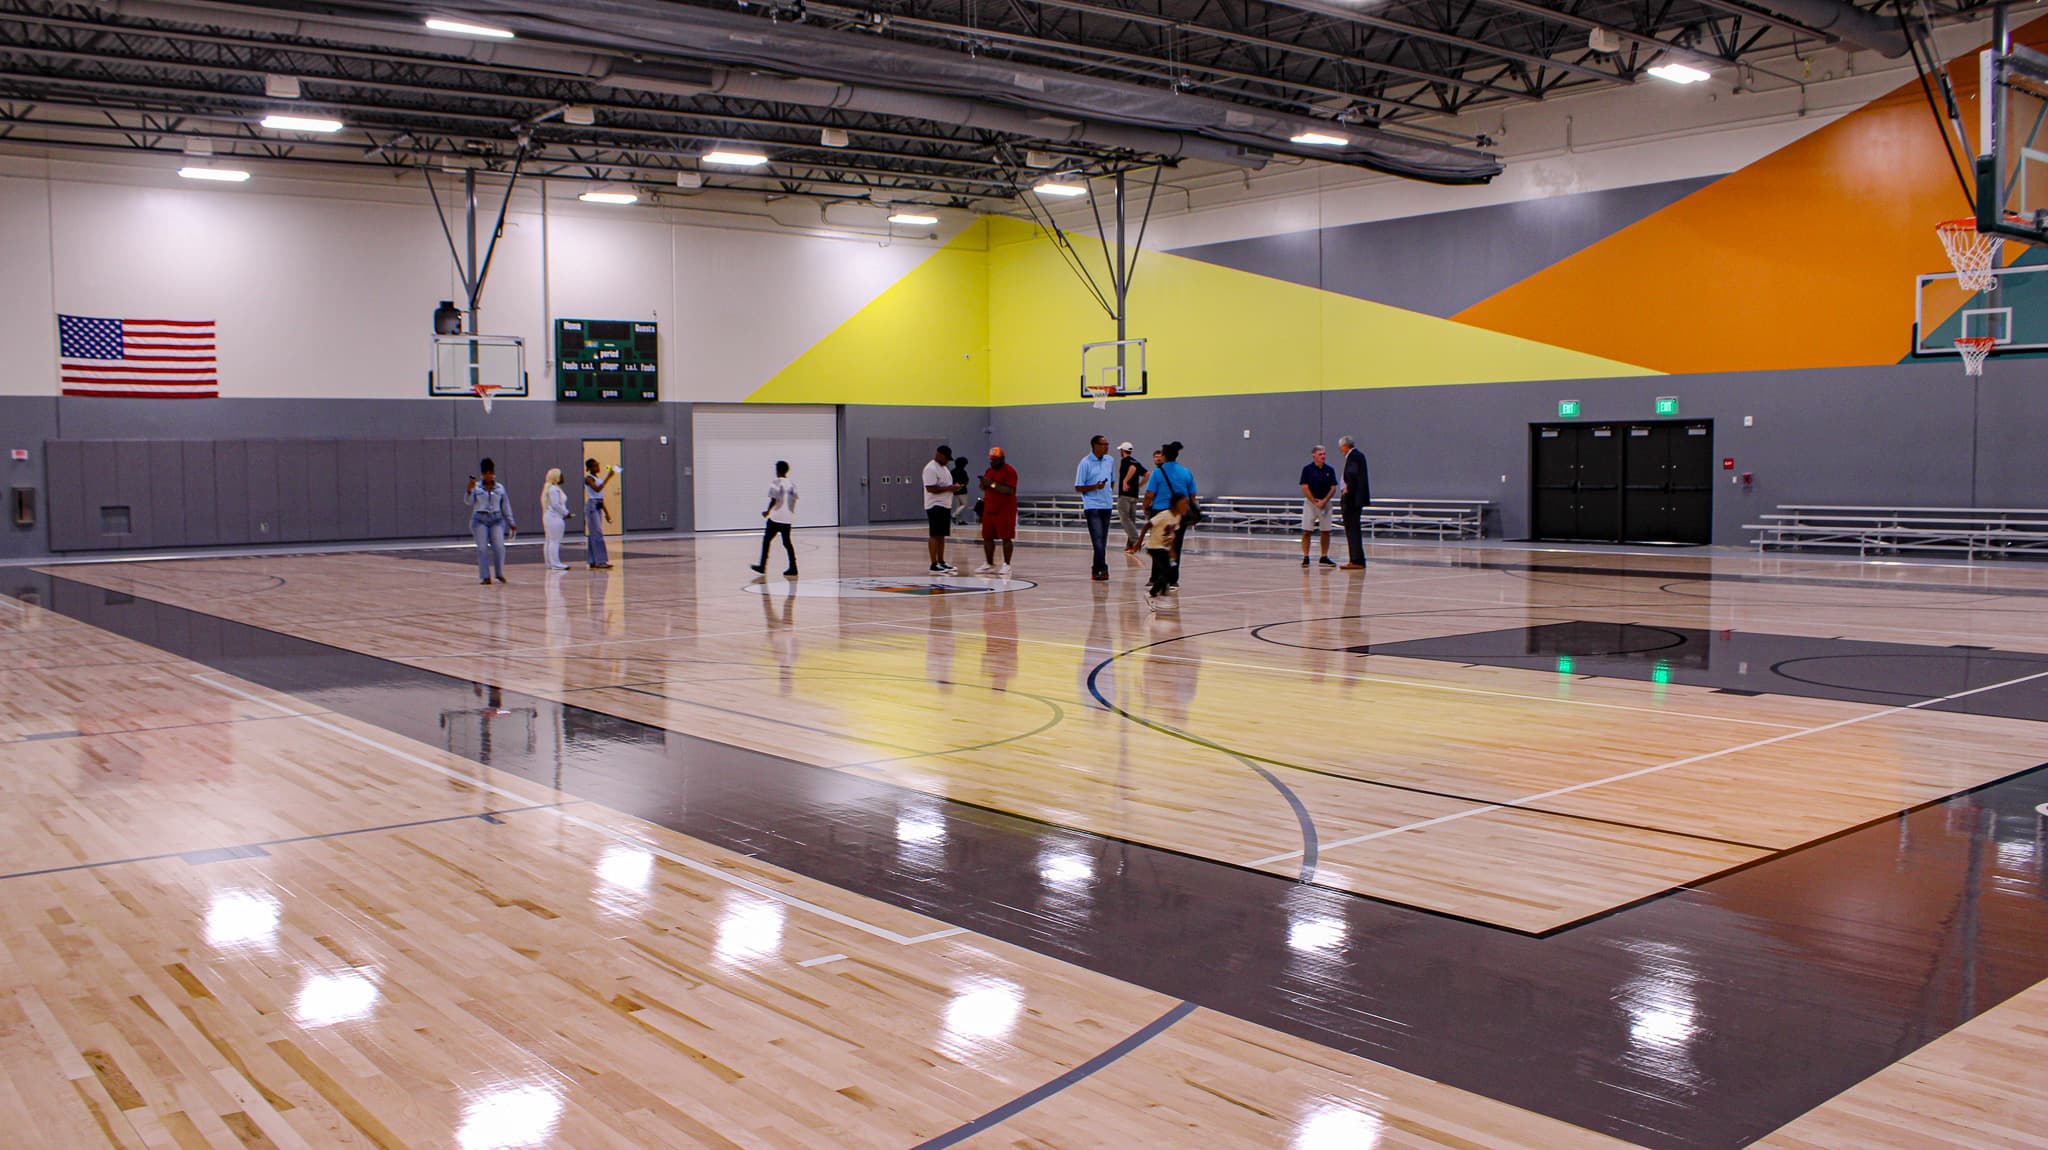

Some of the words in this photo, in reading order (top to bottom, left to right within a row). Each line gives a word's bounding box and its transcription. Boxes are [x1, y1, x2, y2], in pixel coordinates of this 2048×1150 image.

[599, 350, 619, 359] period
[1562, 403, 1574, 414] EXIT
[1660, 401, 1672, 412] EXIT
